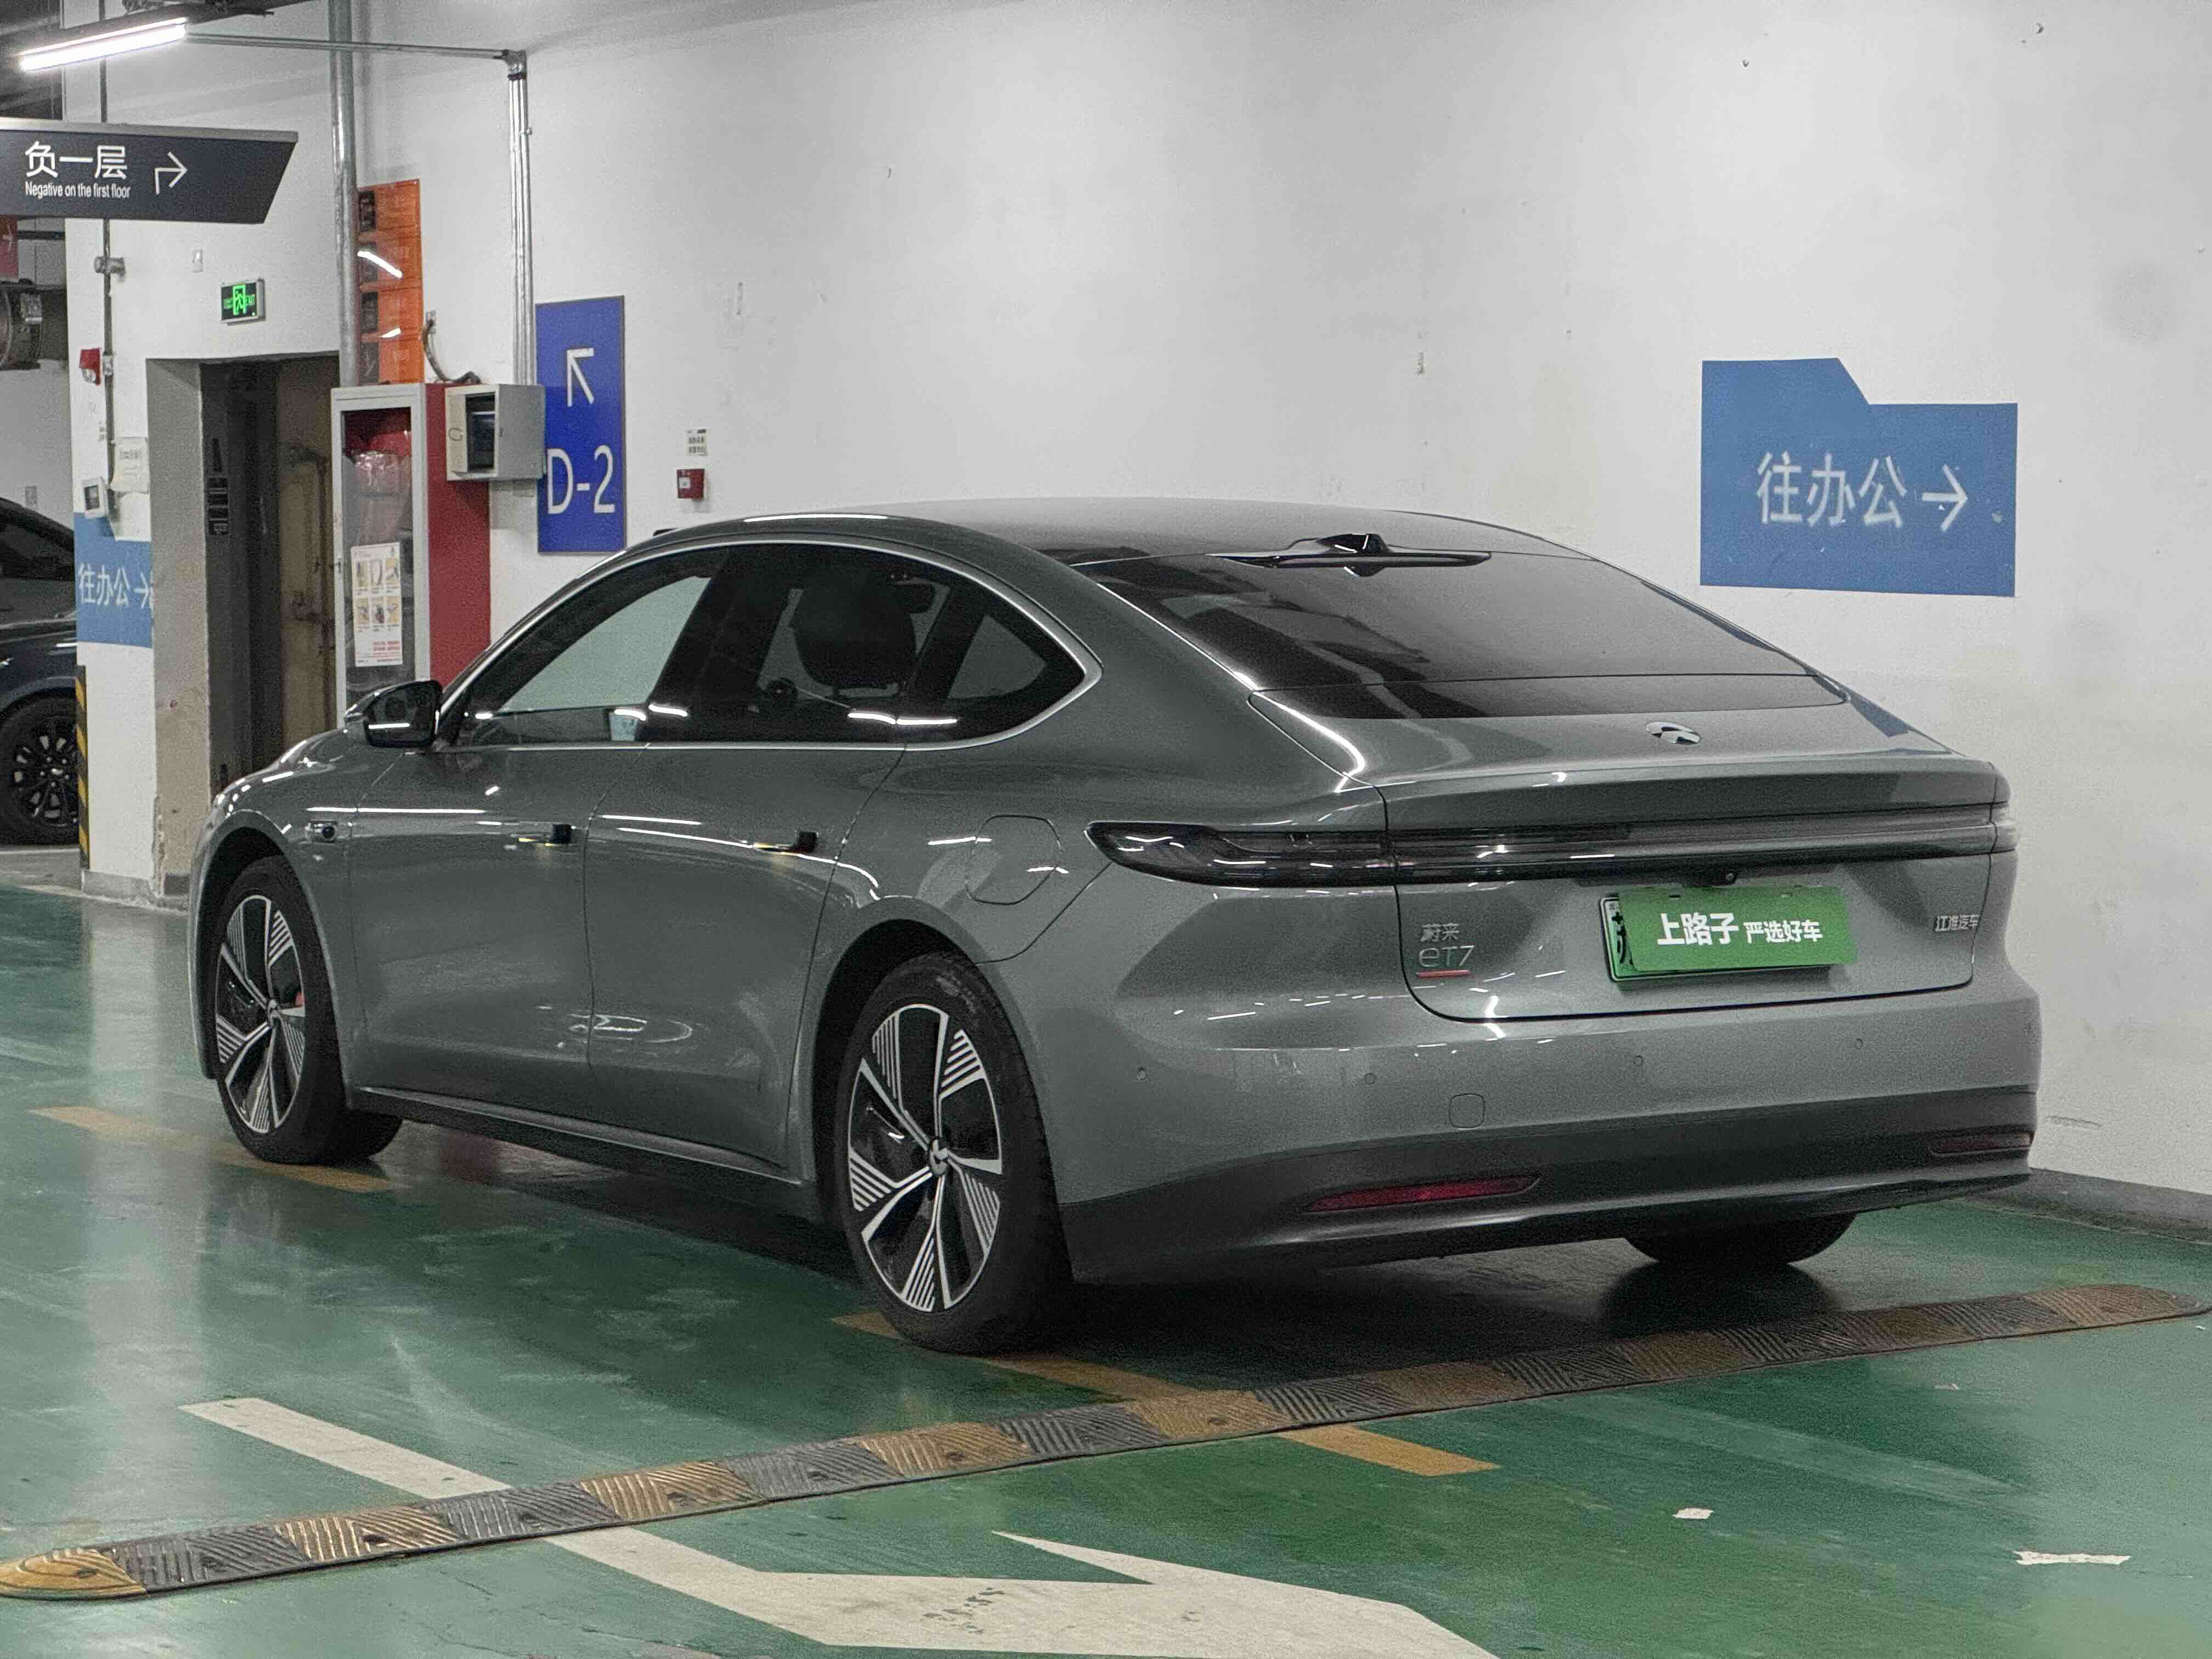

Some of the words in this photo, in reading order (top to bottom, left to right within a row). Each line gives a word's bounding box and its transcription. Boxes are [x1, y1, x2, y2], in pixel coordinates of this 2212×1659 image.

[25, 141, 128, 179] 负一层
[25, 181, 63, 200] Negative
[64, 185, 76, 197] on
[78, 183, 94, 198] the
[93, 183, 110, 198] first
[111, 183, 131, 198] floor
[548, 445, 615, 514] D-2
[1756, 452, 1908, 528] 往办公
[78, 563, 130, 608] 往办公
[1657, 912, 1739, 946] 上路子
[1743, 919, 1823, 944] 严选好车
